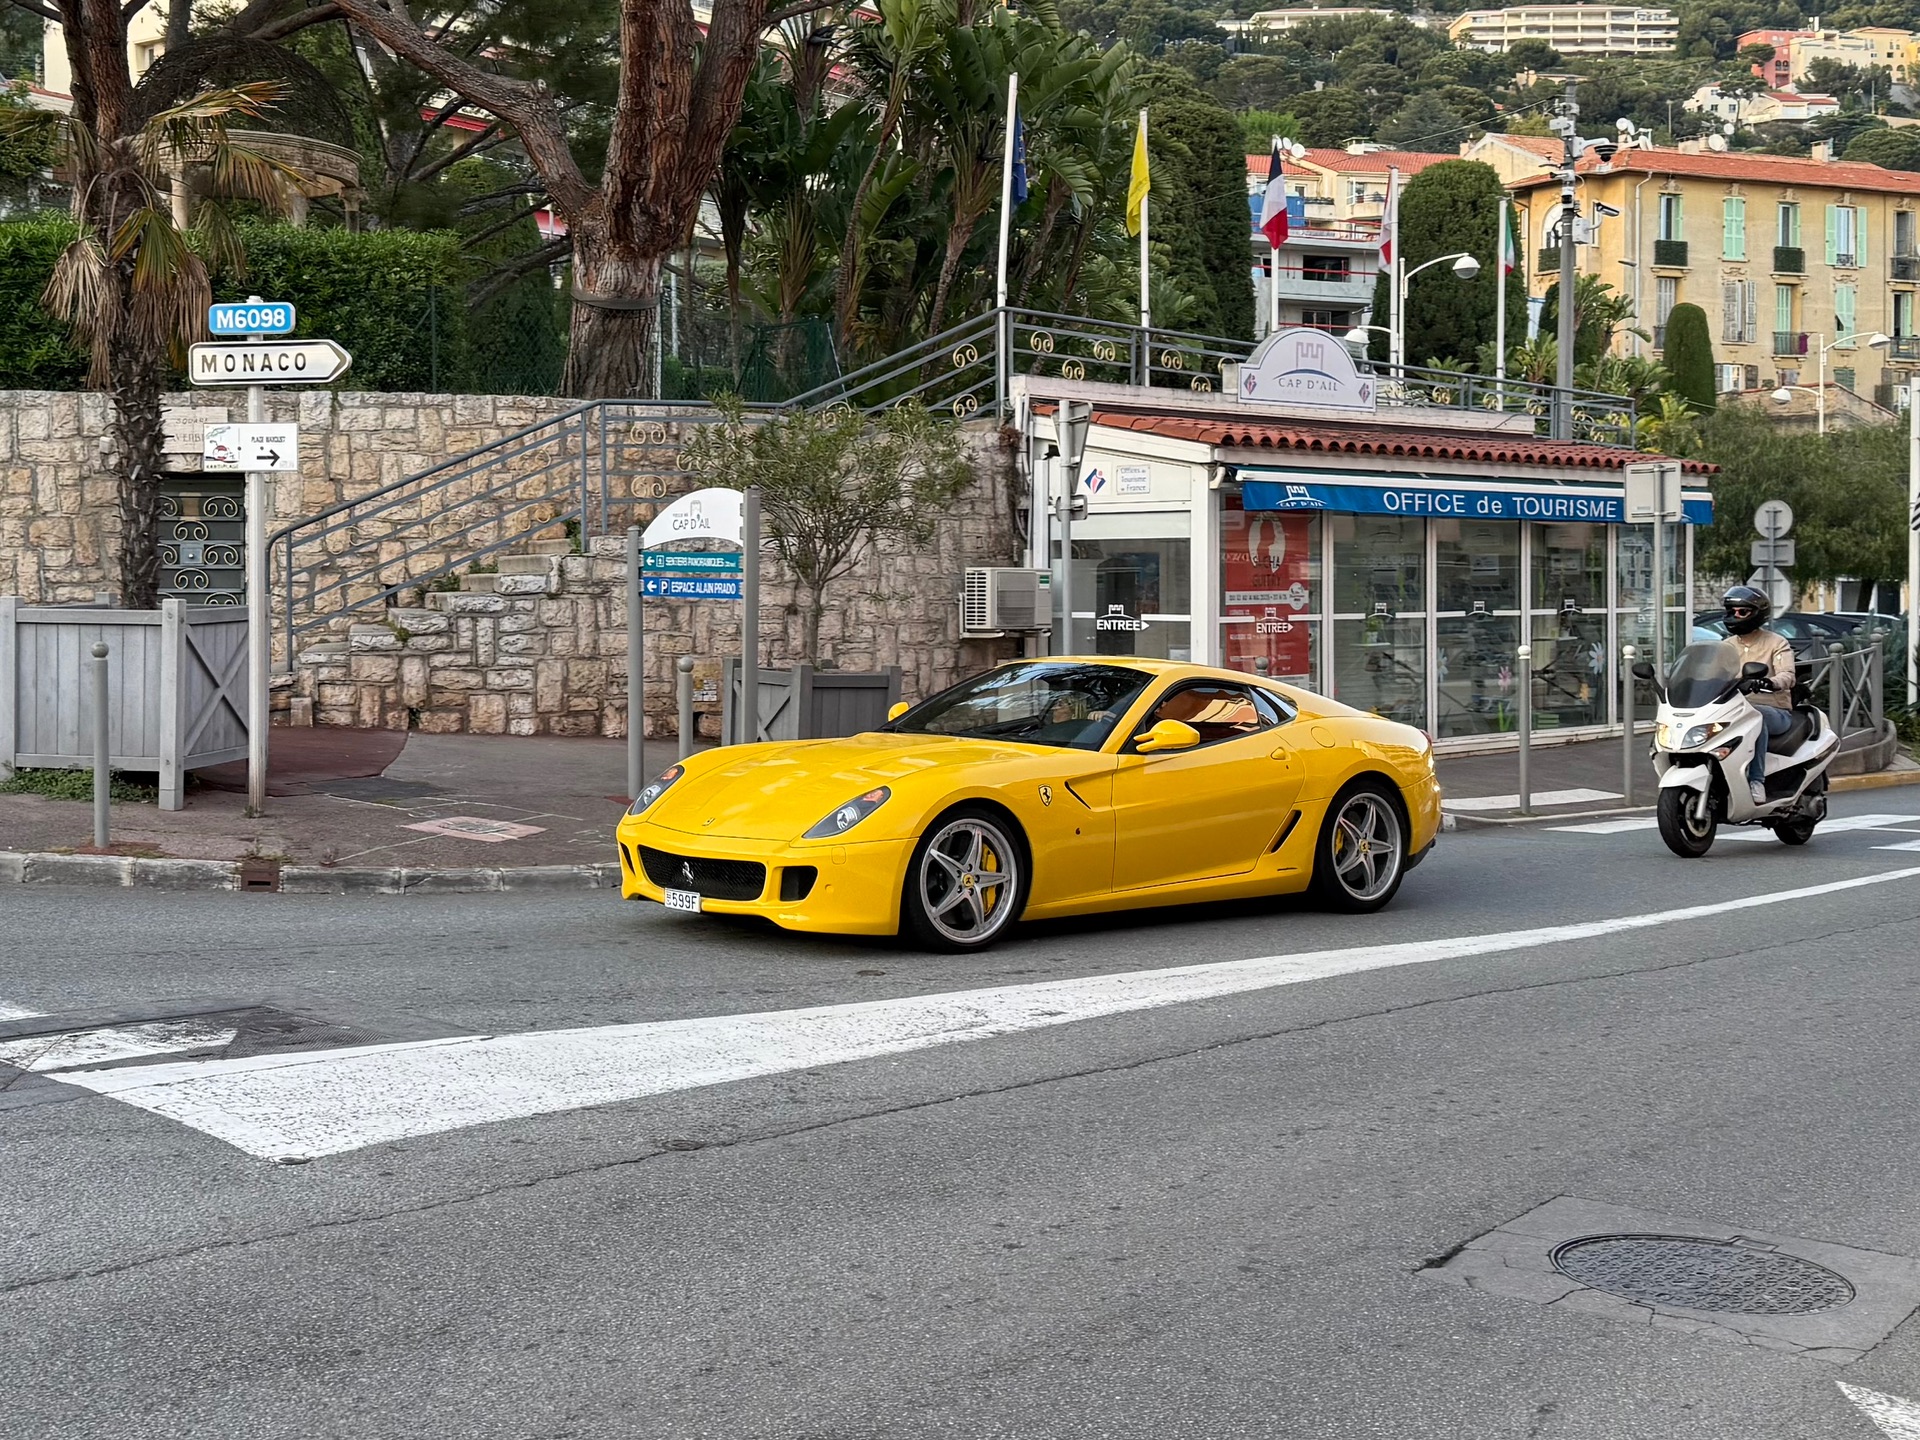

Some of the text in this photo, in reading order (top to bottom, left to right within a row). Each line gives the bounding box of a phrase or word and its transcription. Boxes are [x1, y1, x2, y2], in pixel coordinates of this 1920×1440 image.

[216, 308, 286, 329] M6098
[201, 352, 307, 374] MONACO
[1278, 377, 1338, 391] CAP D'AIL
[1383, 491, 1618, 518] OFFICE de TOURISME
[672, 518, 689, 531] CAP
[661, 581, 736, 595] P ESPACE ALAIN PRADO
[1096, 619, 1141, 631] ENTREE
[1256, 622, 1289, 633] ENTREE
[672, 892, 697, 909] 599F
